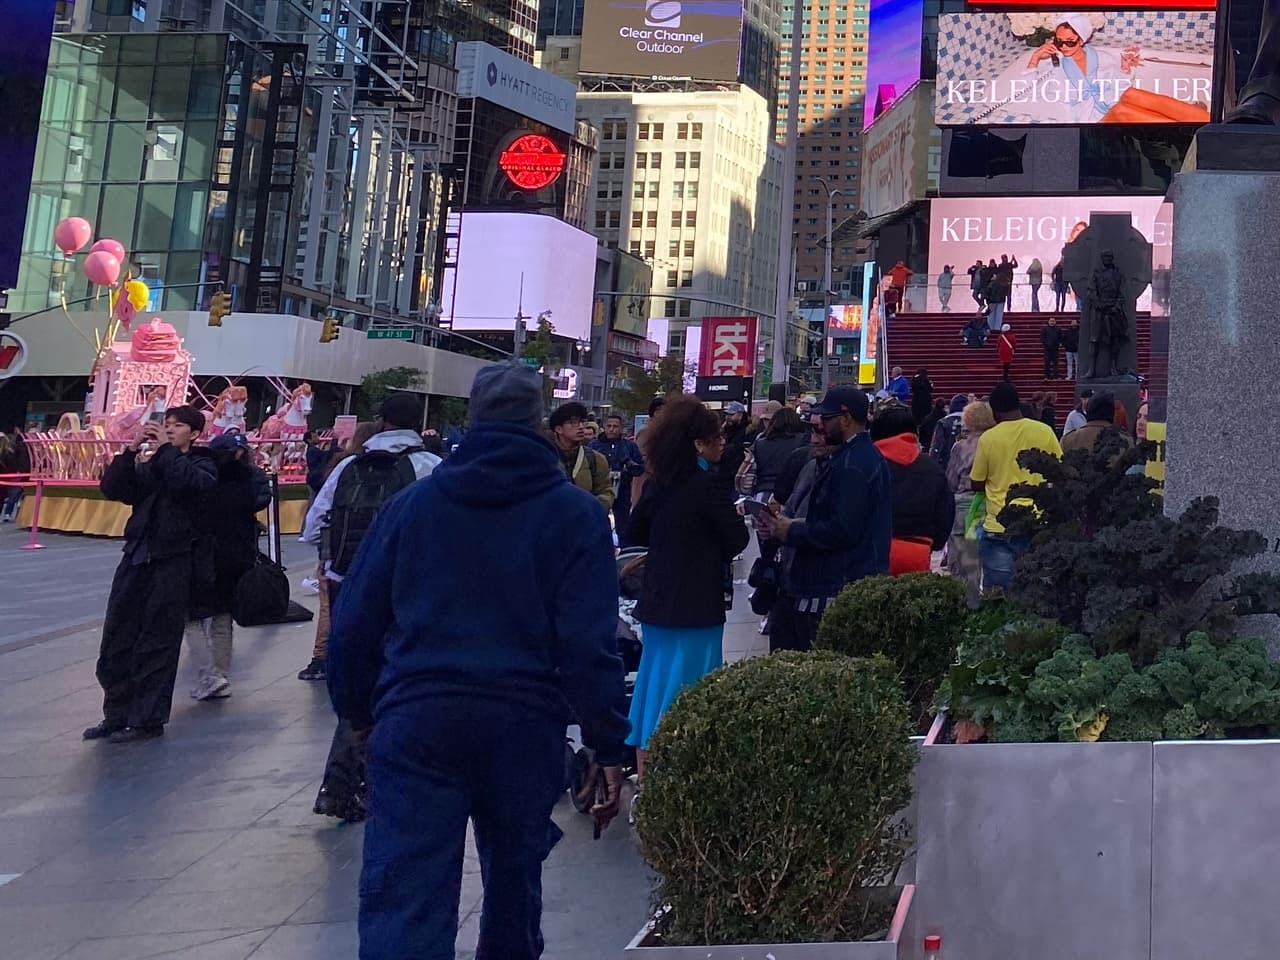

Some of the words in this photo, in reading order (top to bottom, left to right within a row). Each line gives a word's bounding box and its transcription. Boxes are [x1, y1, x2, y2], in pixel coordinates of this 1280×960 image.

[619, 26, 653, 39] Clear
[654, 29, 704, 43] Channel
[636, 41, 684, 54] Outdoor
[500, 71, 531, 97] HYATT
[531, 84, 570, 113] REGENCY
[947, 79, 1083, 104] KELEIGH
